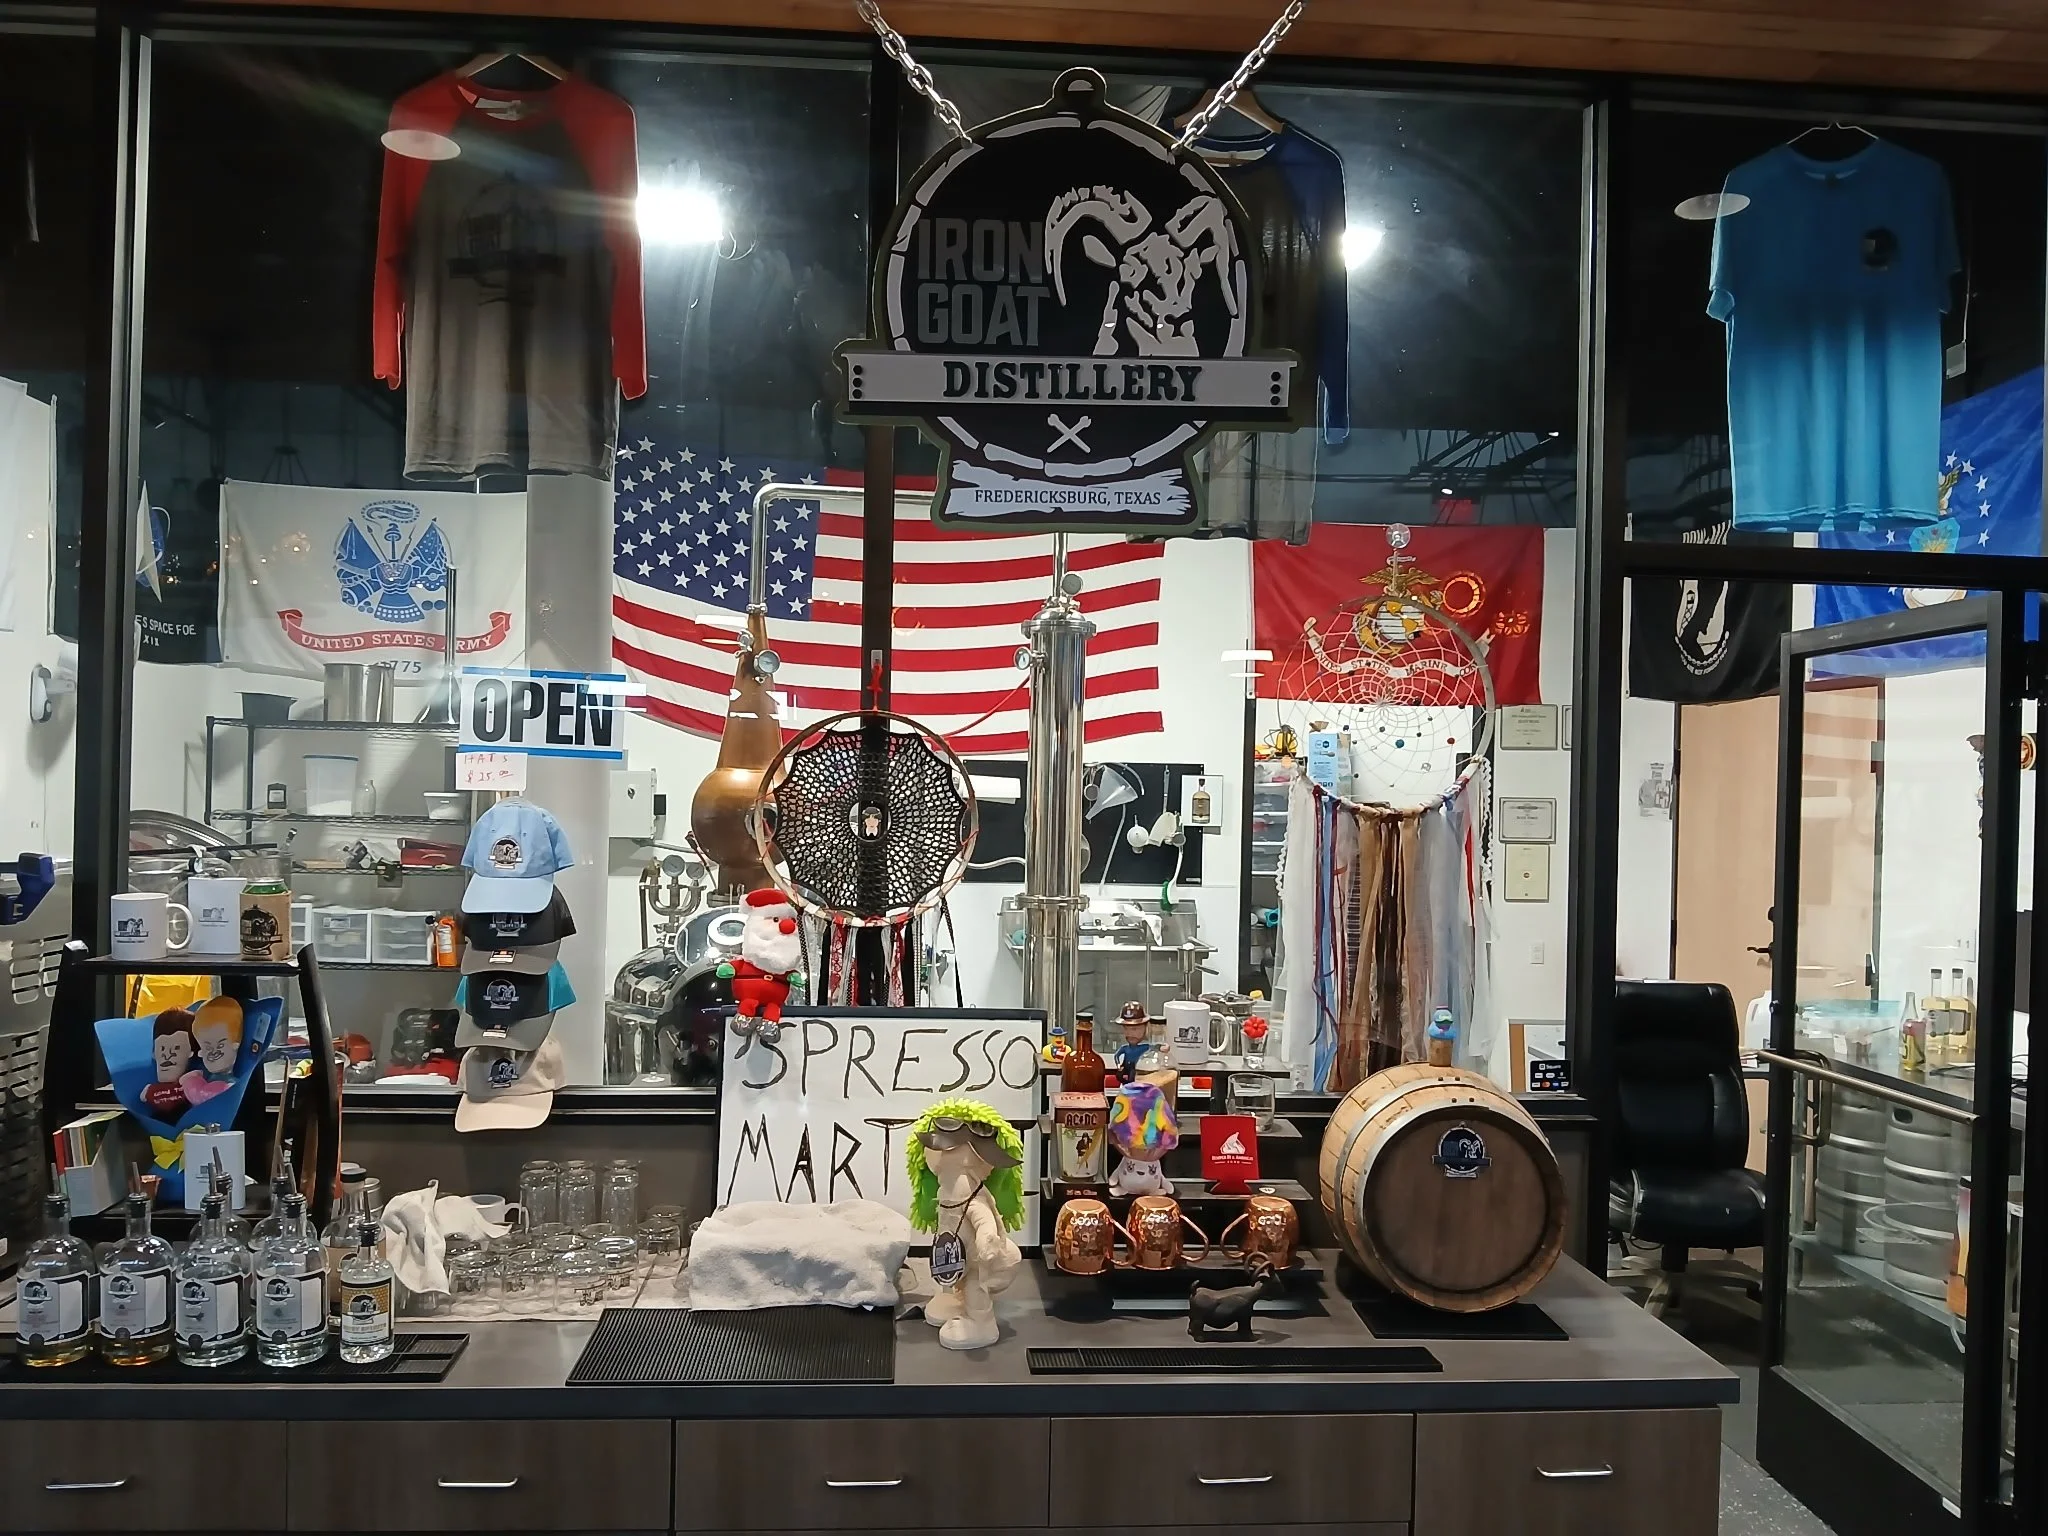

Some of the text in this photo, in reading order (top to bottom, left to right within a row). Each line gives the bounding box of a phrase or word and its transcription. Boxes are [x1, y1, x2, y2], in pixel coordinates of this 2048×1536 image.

[918, 218, 1043, 282] IRON
[917, 283, 1050, 347] GOAT
[942, 360, 1202, 402] DISTILLERY
[974, 488, 1162, 507] FREDERICKSBURG, TEXAS
[149, 618, 174, 635] SPACE
[301, 633, 492, 651] UNITED STATES RMY
[388, 660, 422, 674] 775
[472, 678, 614, 747] OPEN
[464, 753, 509, 765] HATS
